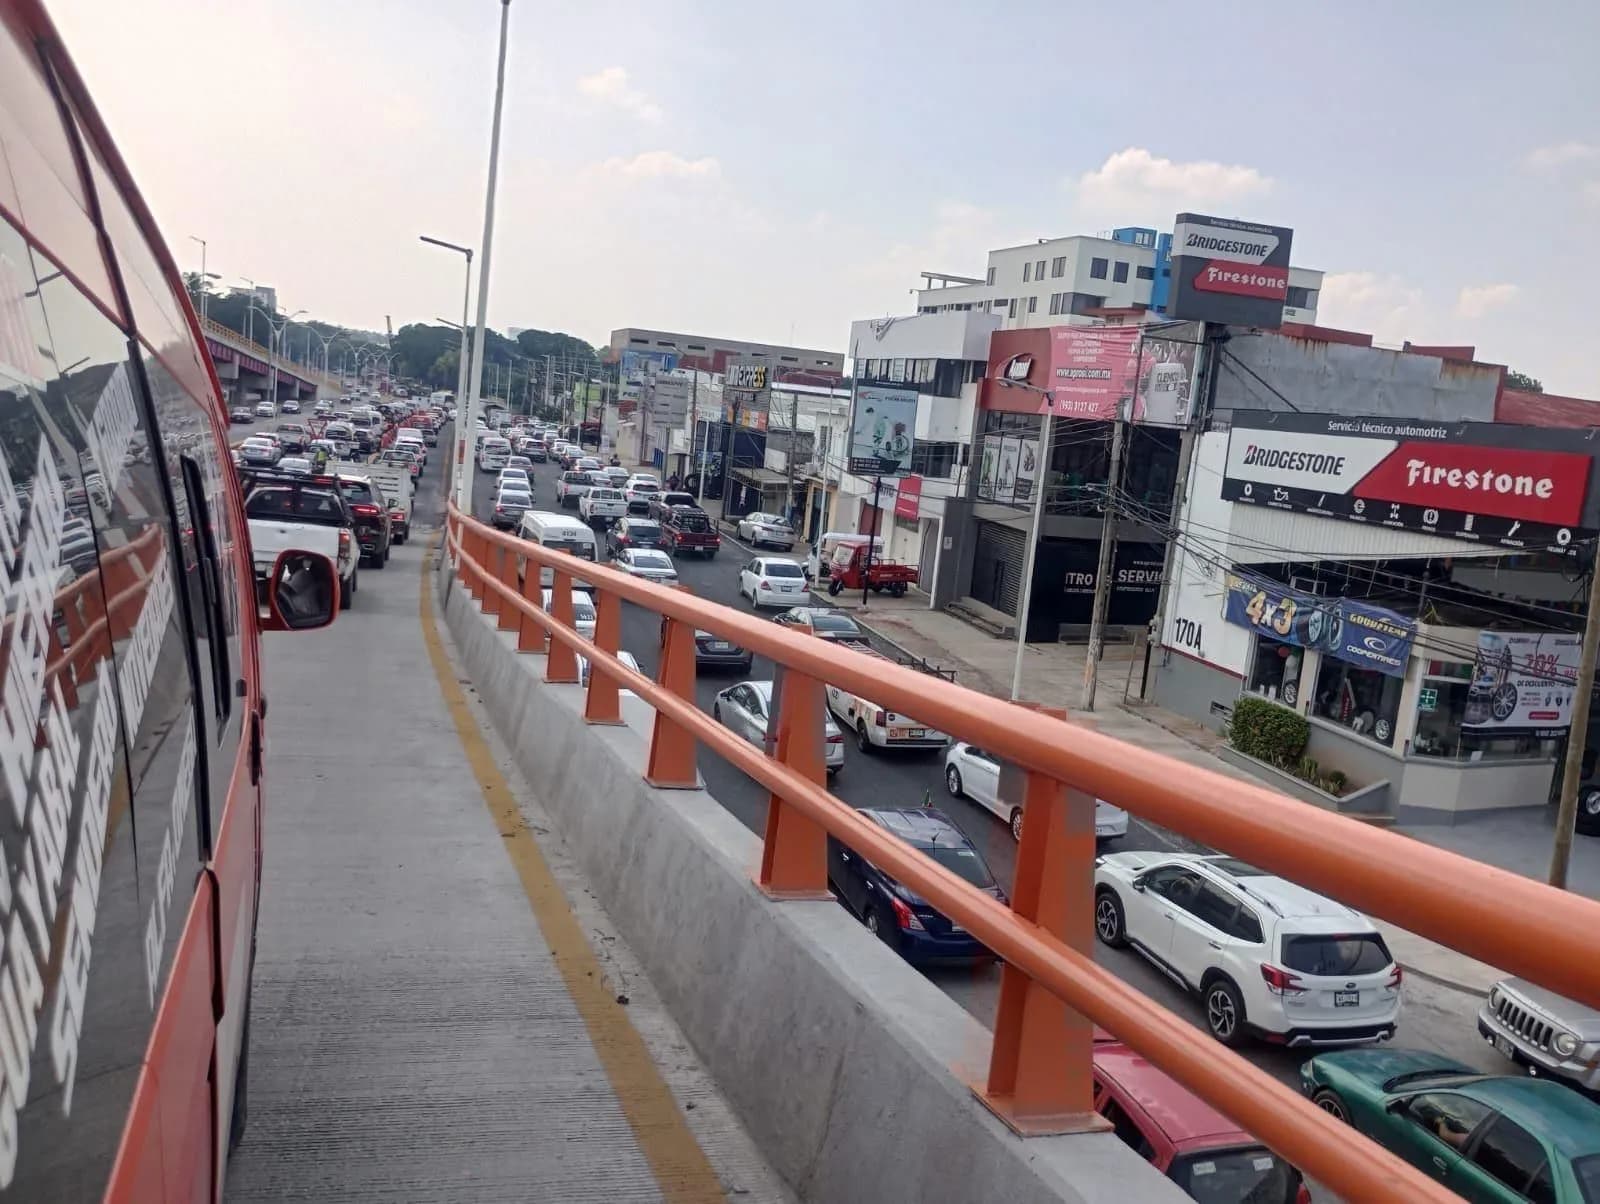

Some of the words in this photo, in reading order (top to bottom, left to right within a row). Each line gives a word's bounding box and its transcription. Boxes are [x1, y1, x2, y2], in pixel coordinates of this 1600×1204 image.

[1186, 233, 1269, 257] BRIDGESTONE
[1207, 266, 1286, 288] Firestone
[1361, 422, 1394, 434] técnico
[1394, 426, 1447, 438] automotriz
[1243, 445, 1346, 476] BRIDGESTONE
[1406, 459, 1554, 498] Firestone
[50, 655, 118, 1118] SENDERO
